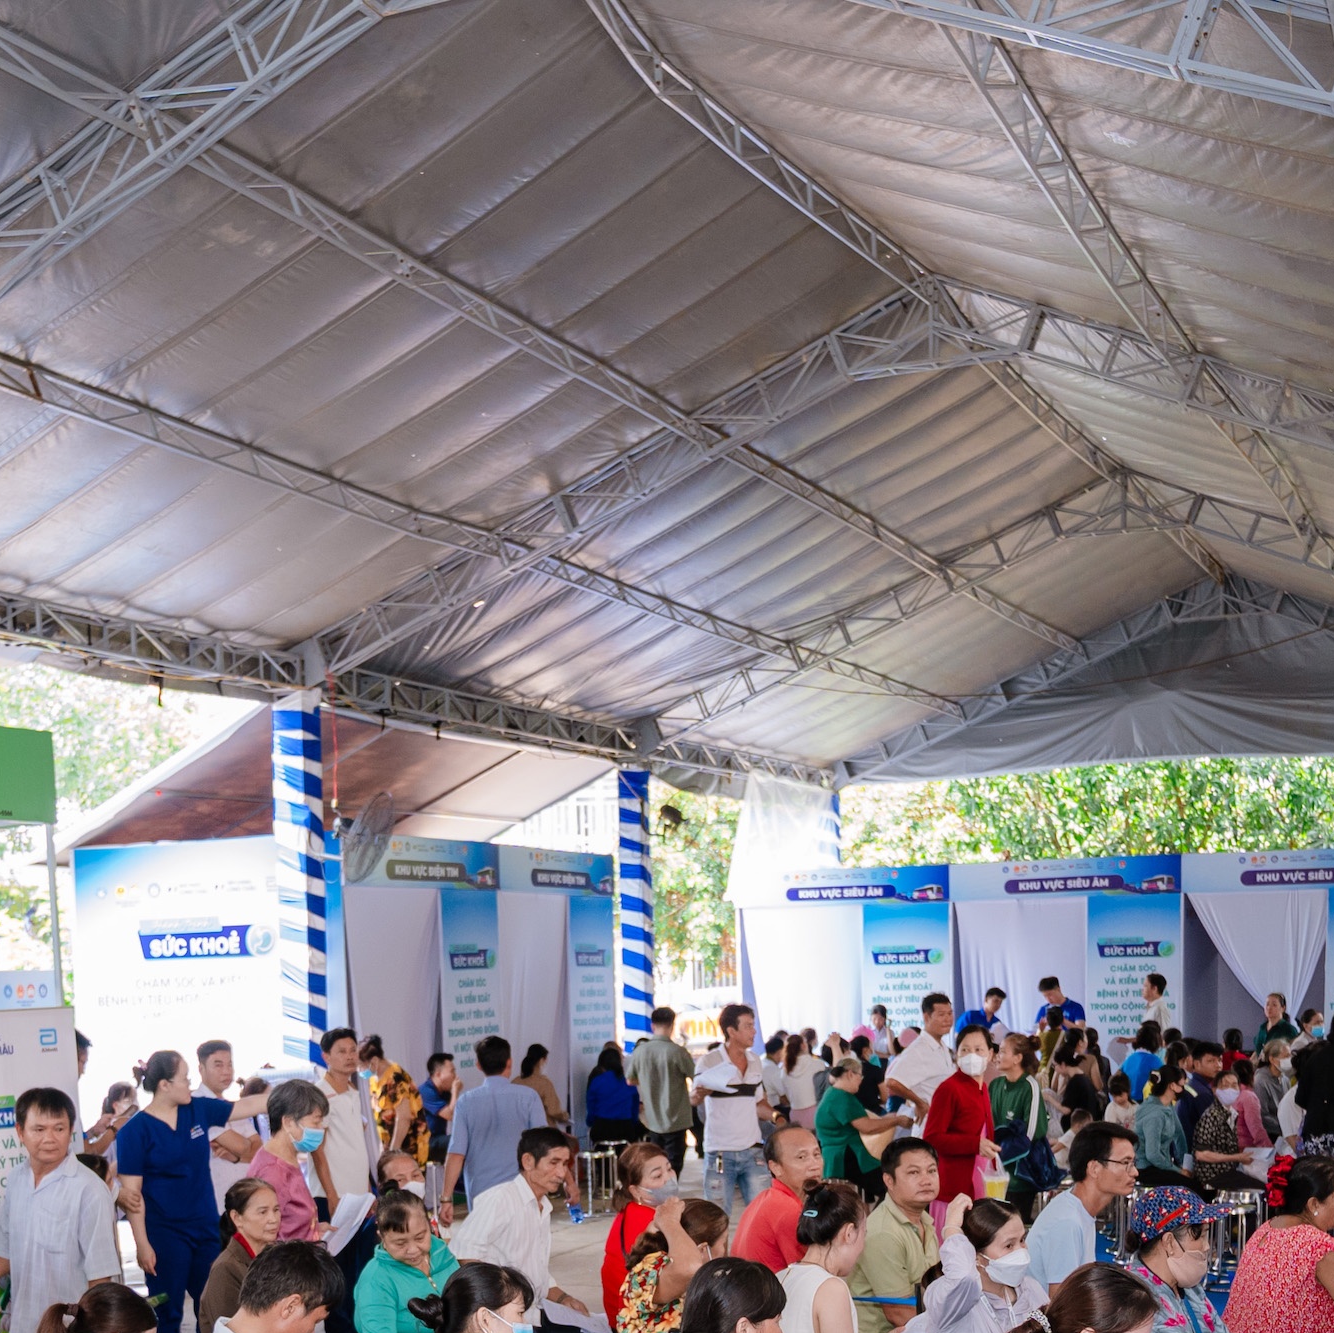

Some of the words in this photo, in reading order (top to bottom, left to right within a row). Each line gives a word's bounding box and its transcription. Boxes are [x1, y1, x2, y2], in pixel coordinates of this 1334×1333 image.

[395, 864, 411, 876] KHU
[446, 866, 460, 878] TIM
[1256, 872, 1279, 883] KHU
[1282, 870, 1305, 883] VỰC
[1308, 868, 1333, 881] SIÊU
[1018, 880, 1041, 891] KHU
[1043, 880, 1065, 892] VỰC
[1067, 877, 1090, 889] SIÊU
[1092, 876, 1109, 888] ÂM
[798, 888, 819, 899] KHU
[822, 887, 842, 900] VỰC
[843, 885, 865, 898] SIÊU
[867, 885, 883, 897] ÂM
[149, 933, 187, 958] SỨC
[189, 930, 240, 956] KHOẺ
[1104, 945, 1124, 956] SỨC
[1126, 944, 1154, 955] KHOẺ
[1, 1137, 17, 1150] VÀ
